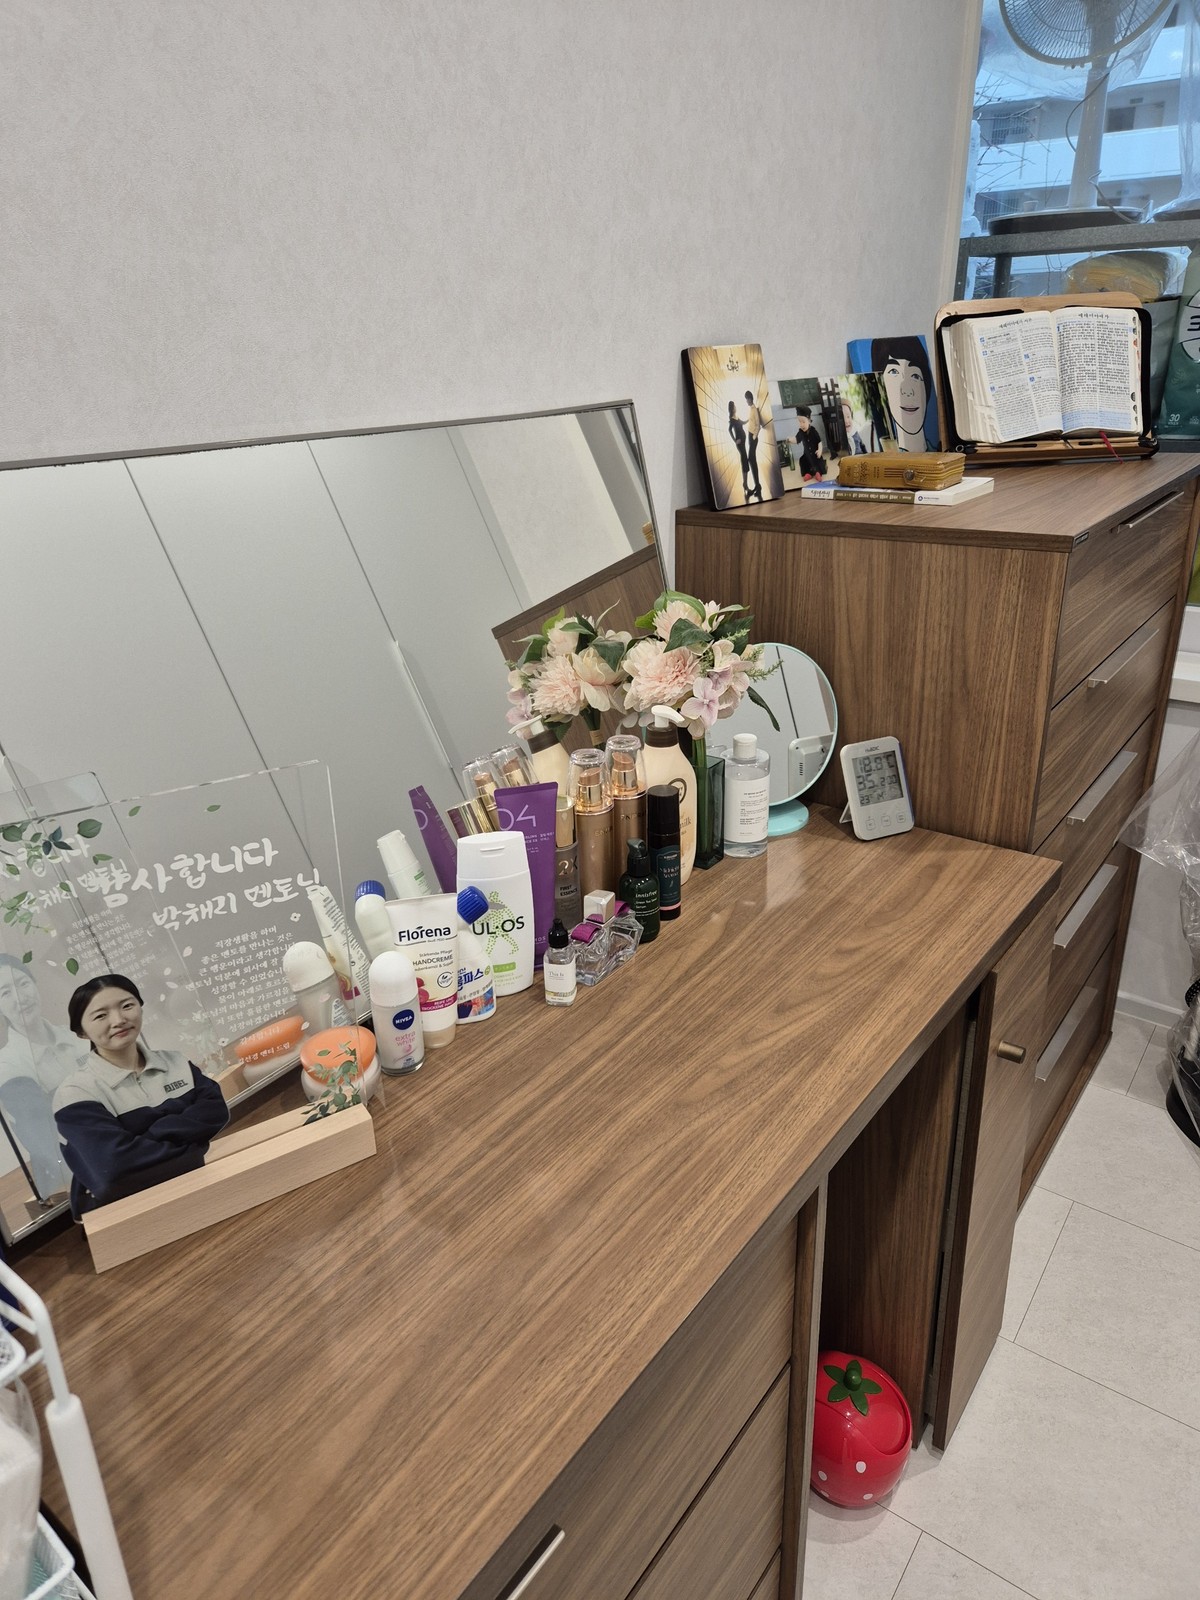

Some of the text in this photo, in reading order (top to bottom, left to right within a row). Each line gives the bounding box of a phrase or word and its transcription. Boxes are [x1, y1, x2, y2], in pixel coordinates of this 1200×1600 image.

[560, 888, 578, 897] ESSENCE
[635, 890, 658, 898] innisfree
[152, 892, 238, 932] 박채리
[260, 925, 277, 937] 하며
[398, 926, 451, 942] Florena
[249, 938, 275, 951] 만나는
[277, 932, 294, 943] 것은
[412, 954, 453, 967] HANDCREME
[211, 981, 237, 995] 성장할
[240, 978, 247, 986] 수
[395, 1014, 413, 1025] NIVEA
[395, 1030, 416, 1042] extra
